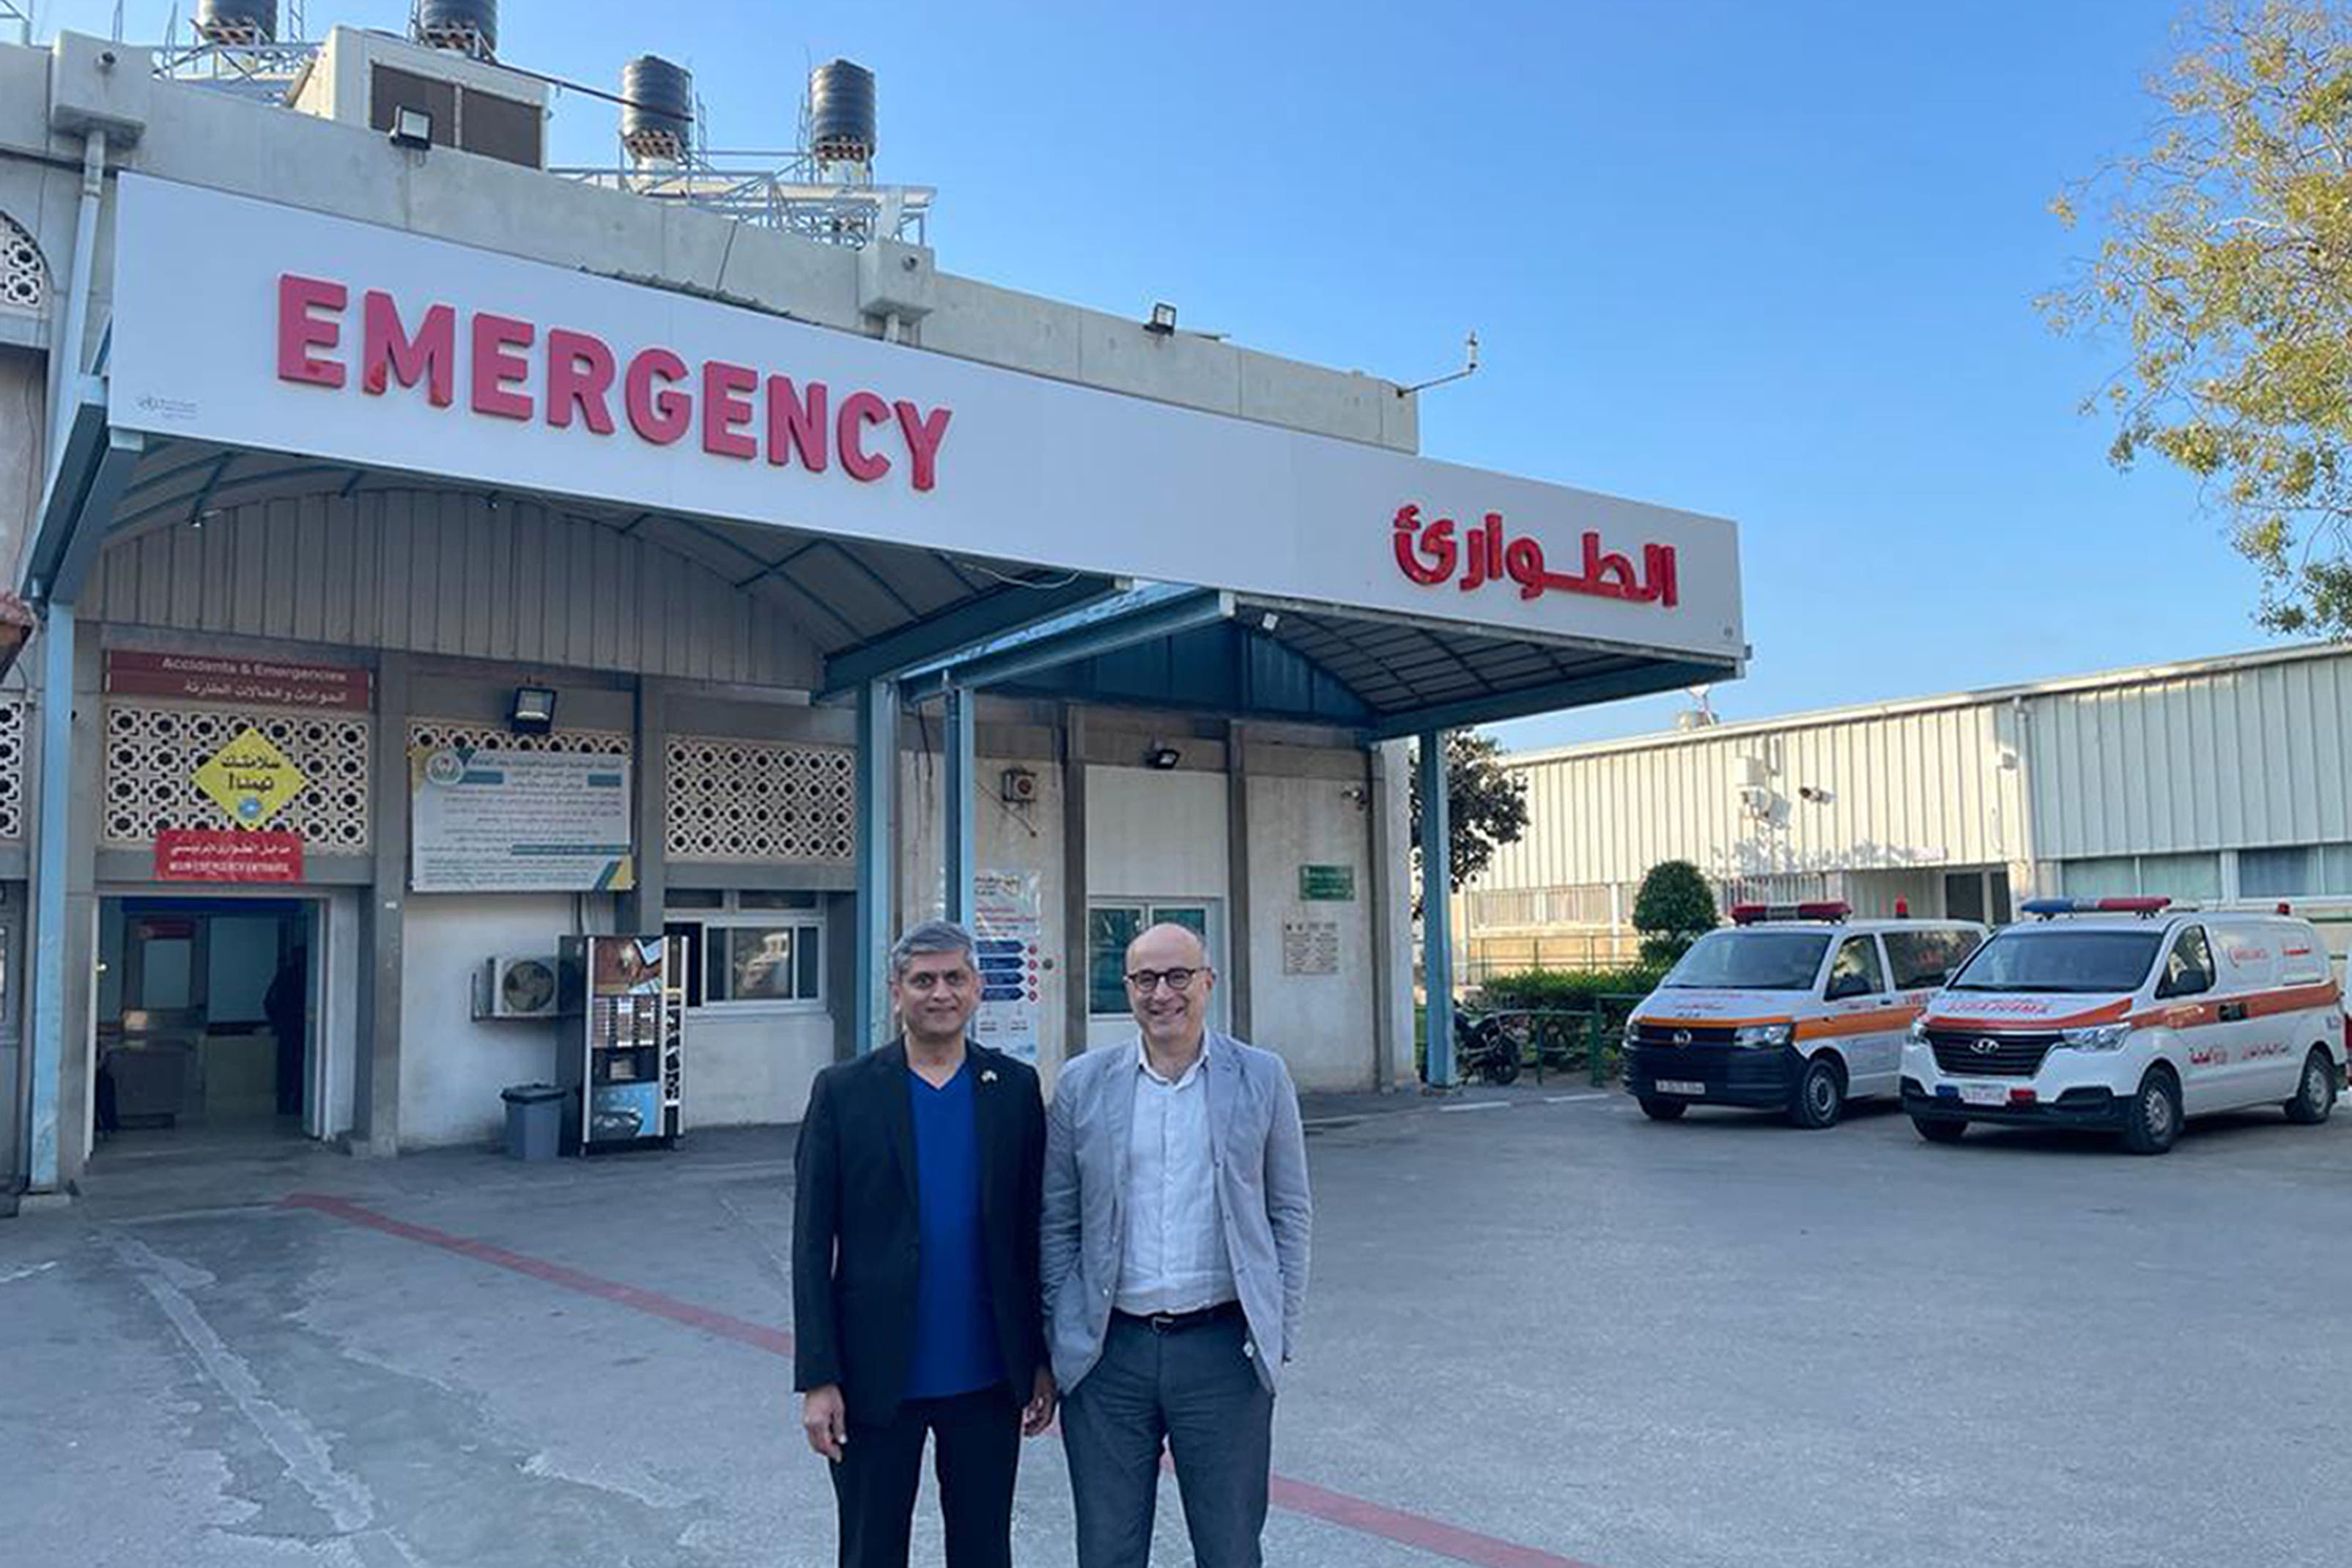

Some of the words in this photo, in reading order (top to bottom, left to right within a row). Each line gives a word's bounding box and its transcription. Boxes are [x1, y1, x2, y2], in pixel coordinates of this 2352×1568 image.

[277, 273, 953, 492] EMERGENCY
[1394, 504, 1678, 607] الطوارئ
[162, 657, 237, 674] Accidents
[240, 663, 251, 675] &
[254, 663, 347, 682] Emergencies
